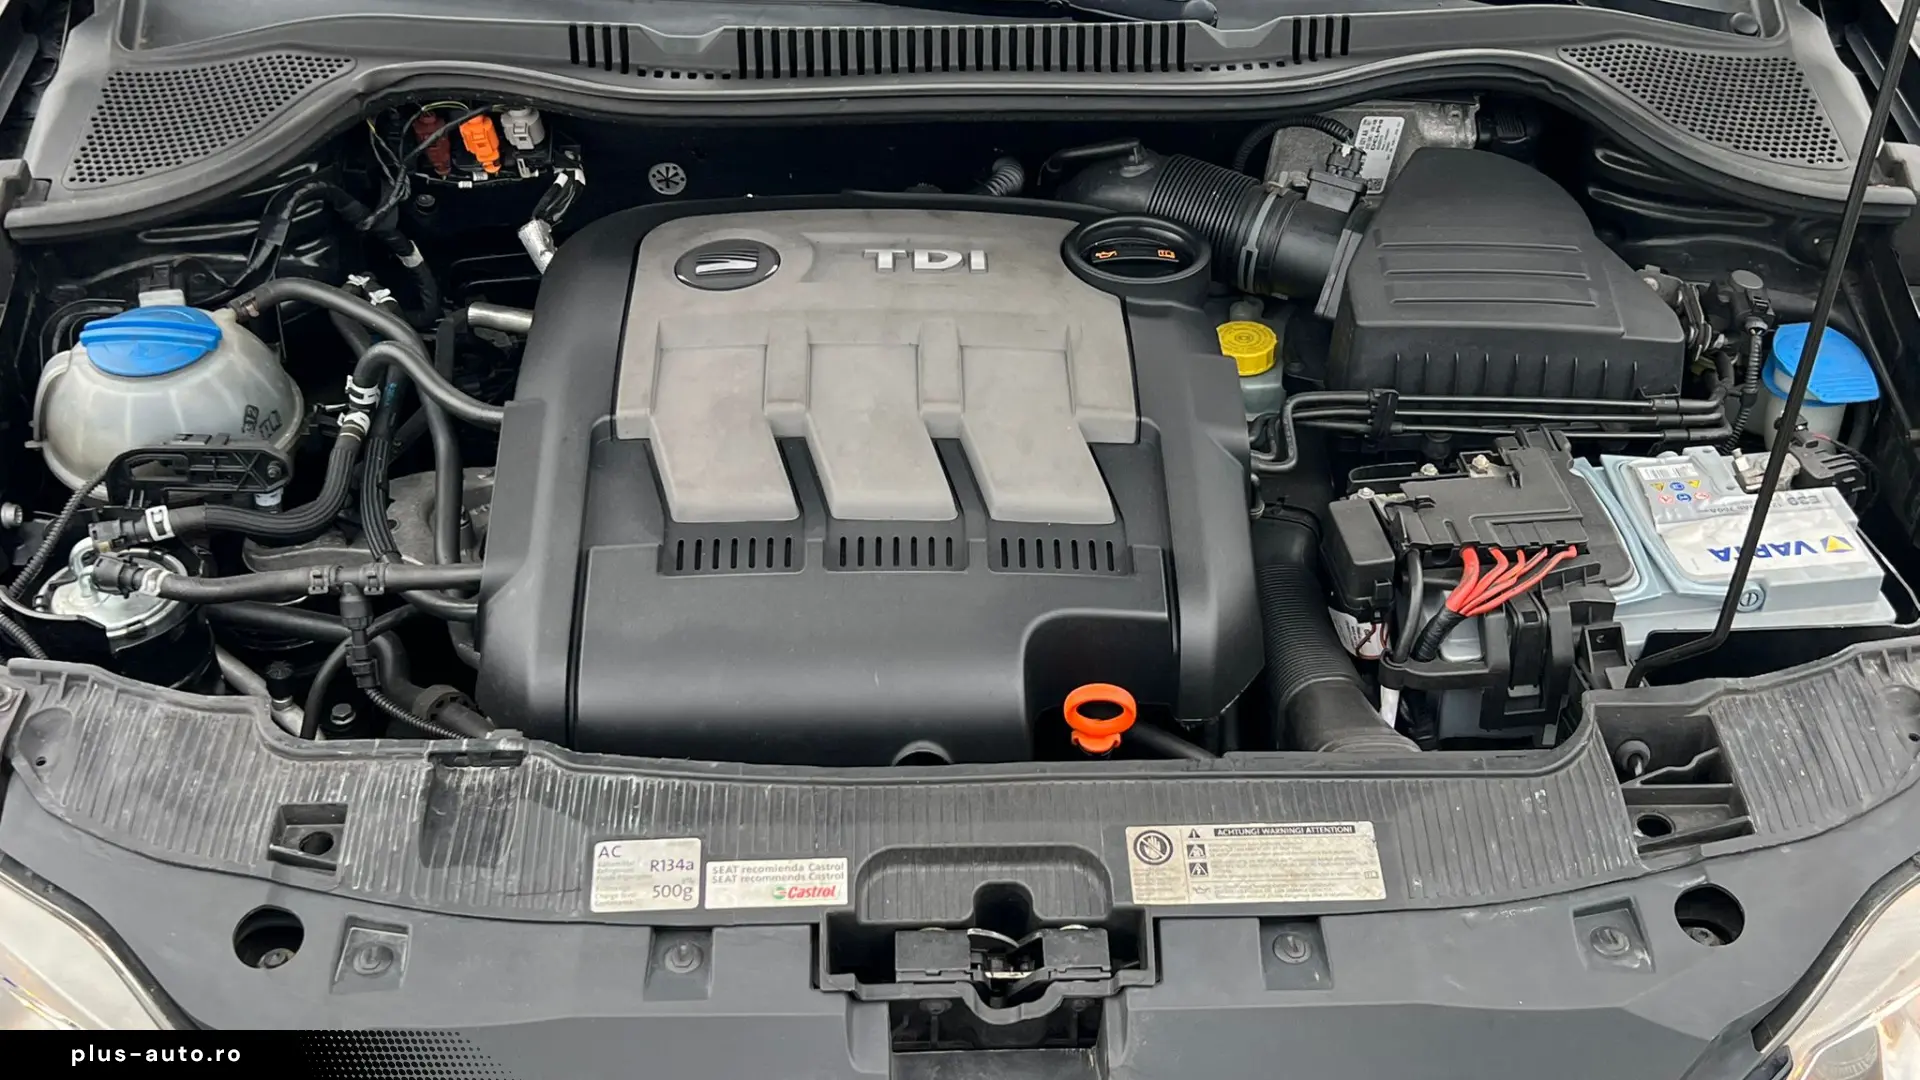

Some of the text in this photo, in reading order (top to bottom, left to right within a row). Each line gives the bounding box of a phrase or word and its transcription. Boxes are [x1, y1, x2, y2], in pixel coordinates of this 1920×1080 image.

[862, 249, 988, 272] TDI
[1217, 825, 1353, 837] ACHTUNG! WARNING! ATTENTION!
[599, 845, 622, 858] AC
[650, 859, 694, 872] R134a
[712, 862, 844, 875] SEAT recomienda Castrol
[712, 871, 844, 884] SEAT recommends Castrol
[652, 884, 693, 901] 500g
[787, 885, 836, 899] Castrol
